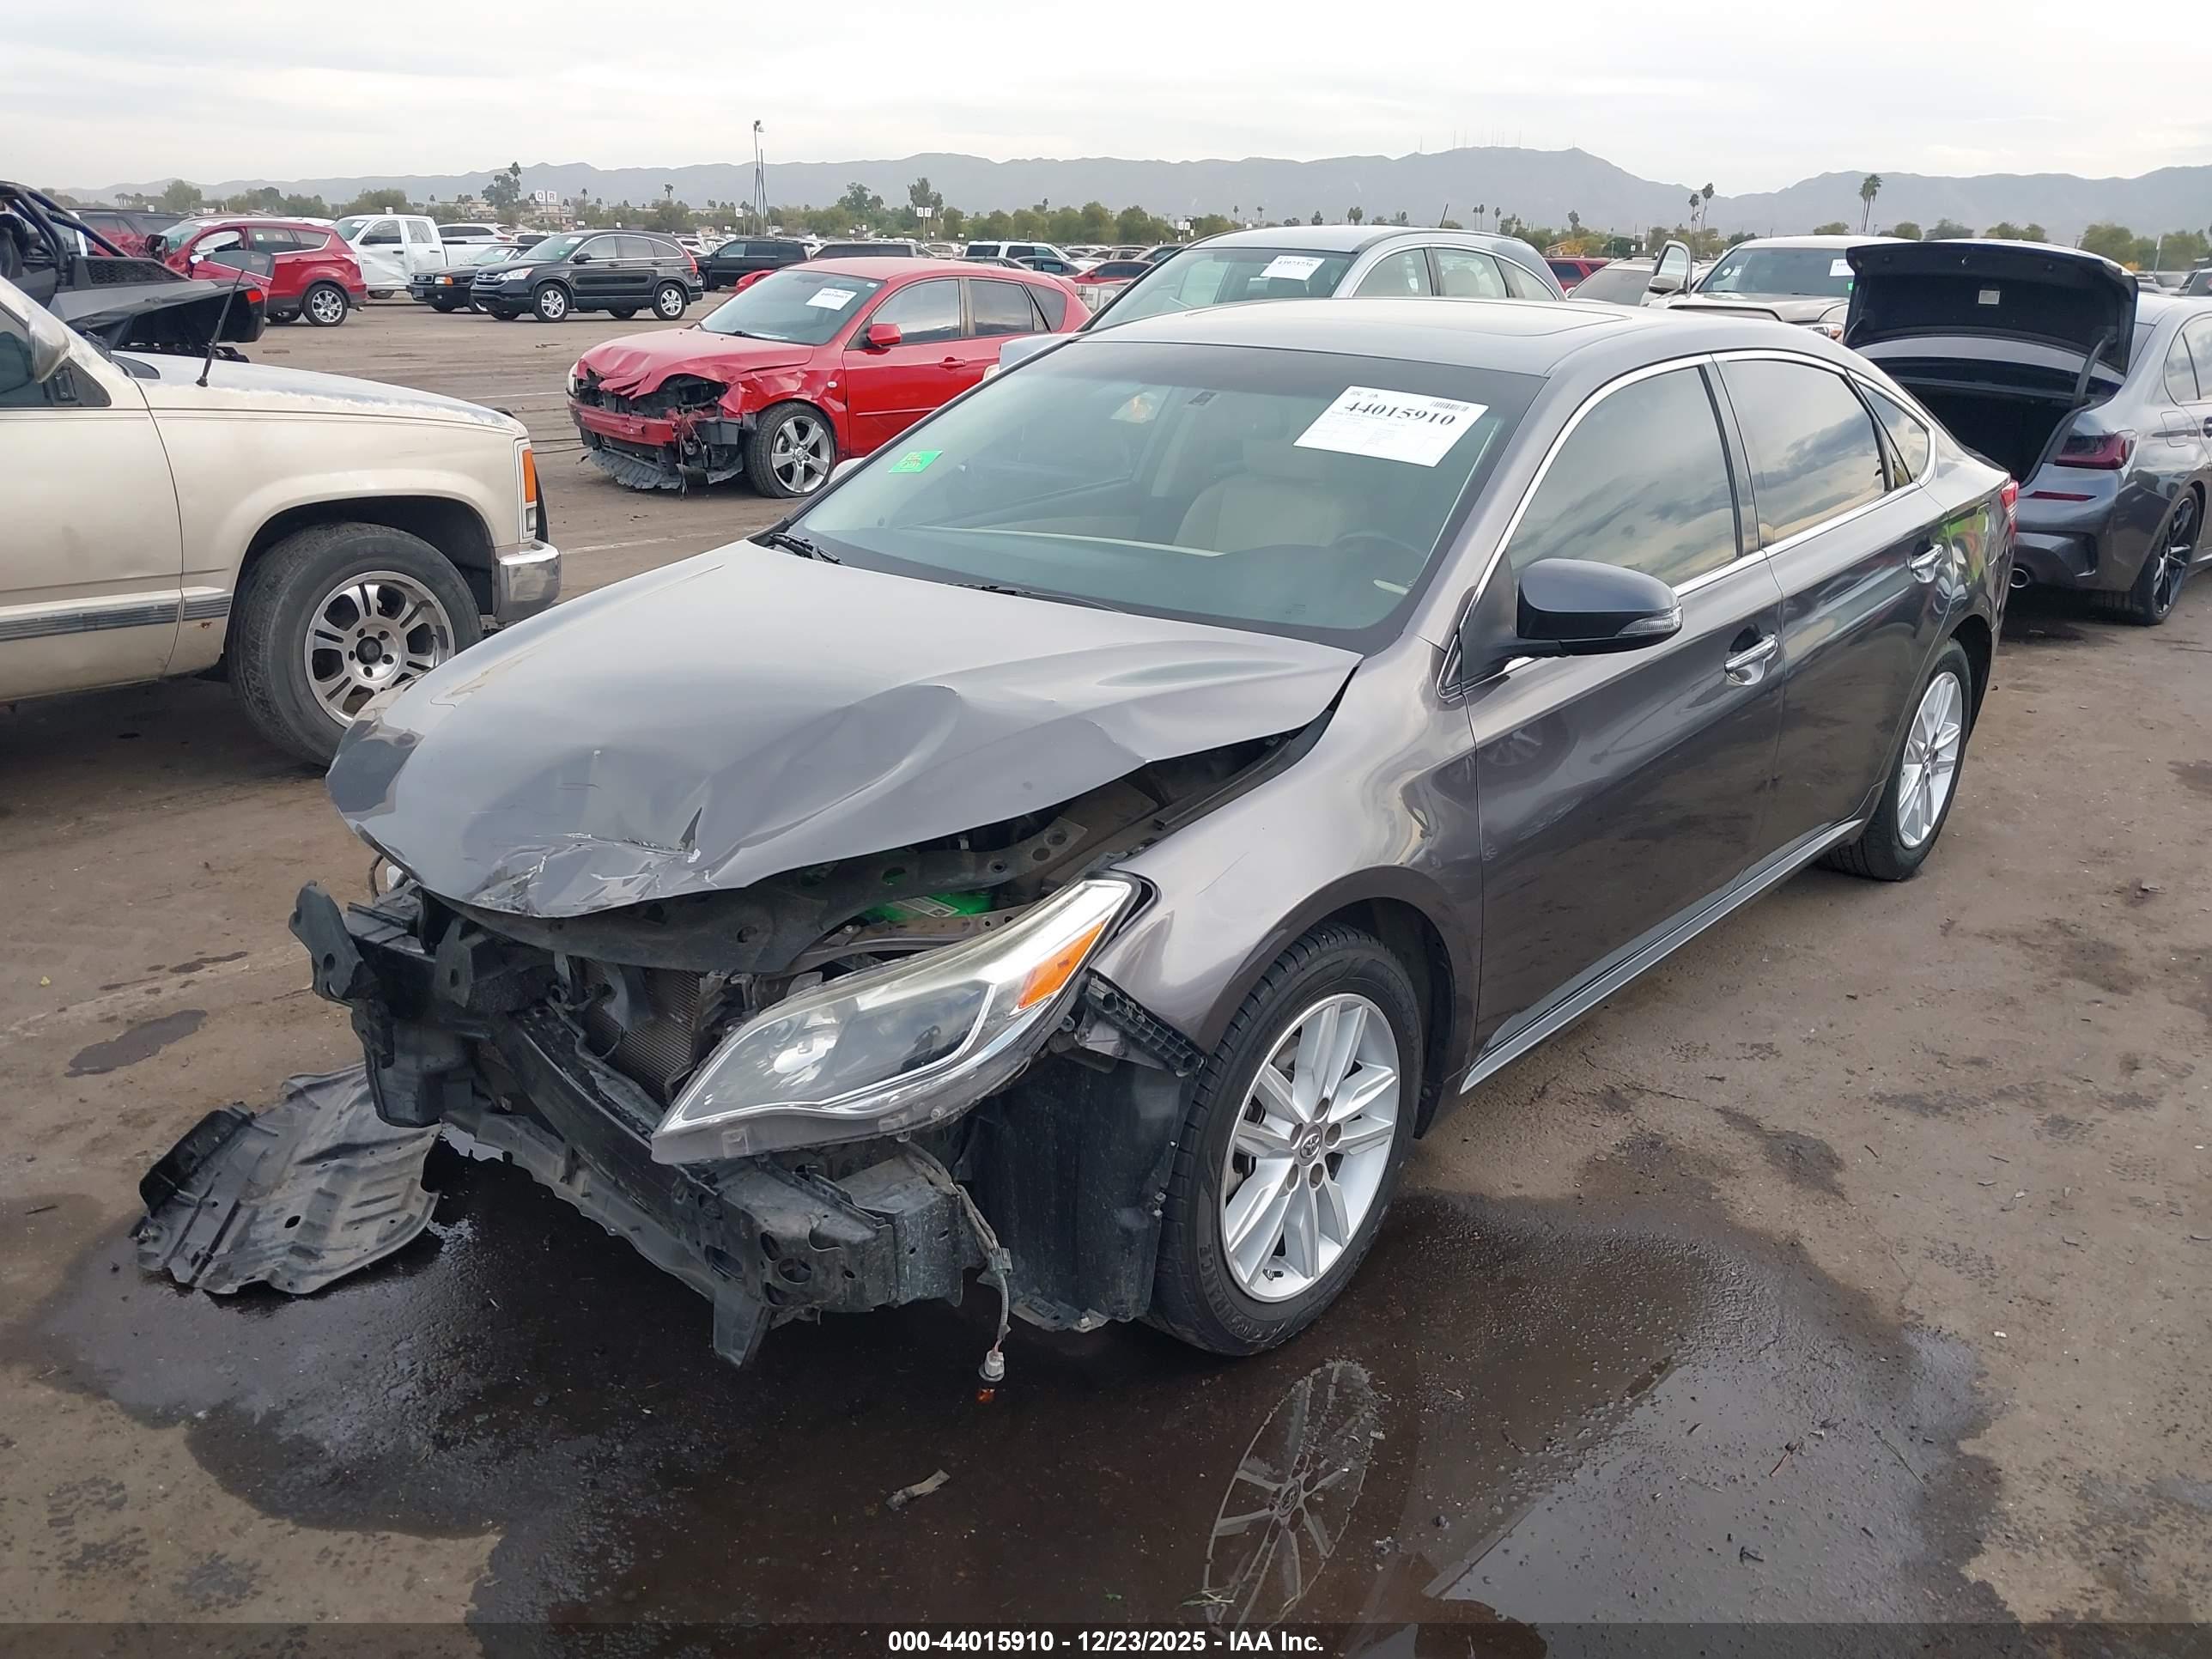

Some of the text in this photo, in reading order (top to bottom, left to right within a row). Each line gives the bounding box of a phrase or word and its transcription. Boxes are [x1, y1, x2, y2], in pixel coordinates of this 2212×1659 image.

[537, 191, 544, 200] Q
[549, 192, 556, 201] R
[1344, 400, 1456, 427] 44015910
